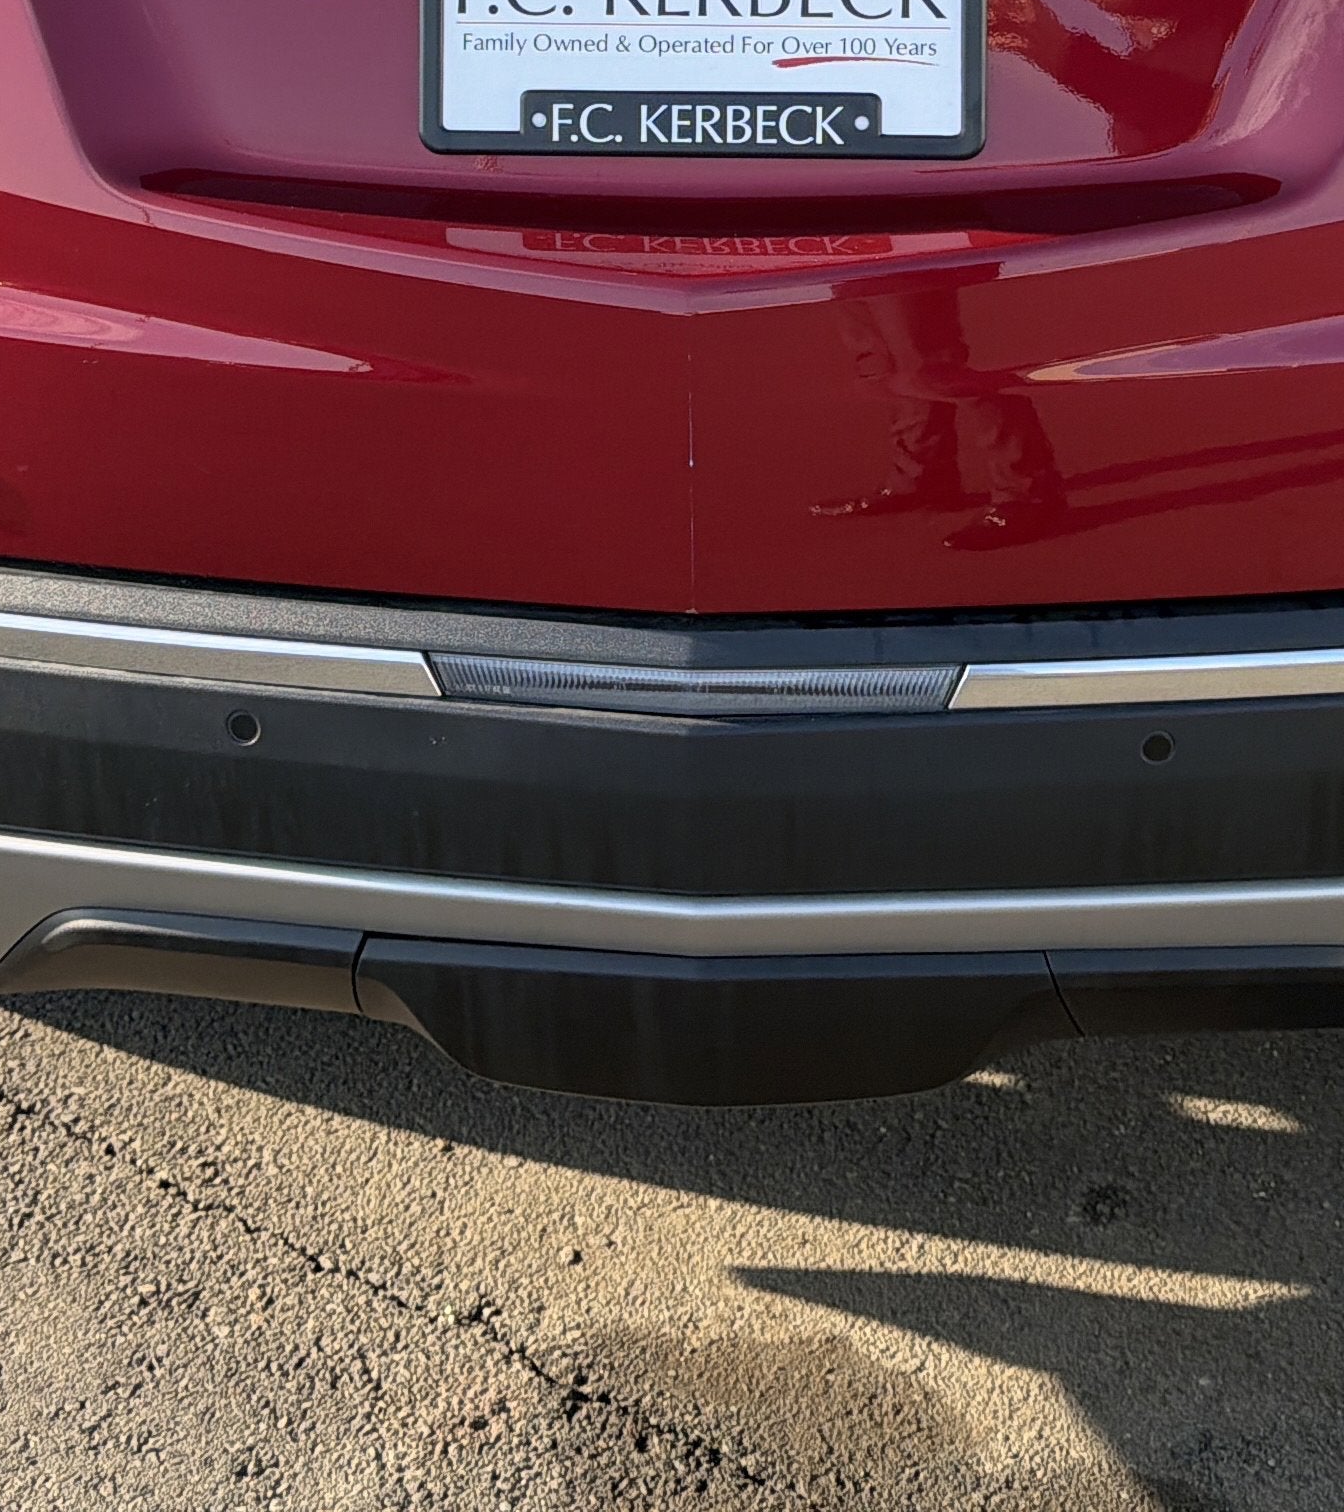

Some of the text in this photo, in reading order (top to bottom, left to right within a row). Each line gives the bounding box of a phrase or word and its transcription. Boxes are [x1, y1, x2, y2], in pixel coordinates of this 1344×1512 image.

[462, 32, 938, 57] Family Owned & Operated For Over 100 Years
[550, 103, 845, 146] F.C. KERBECK
